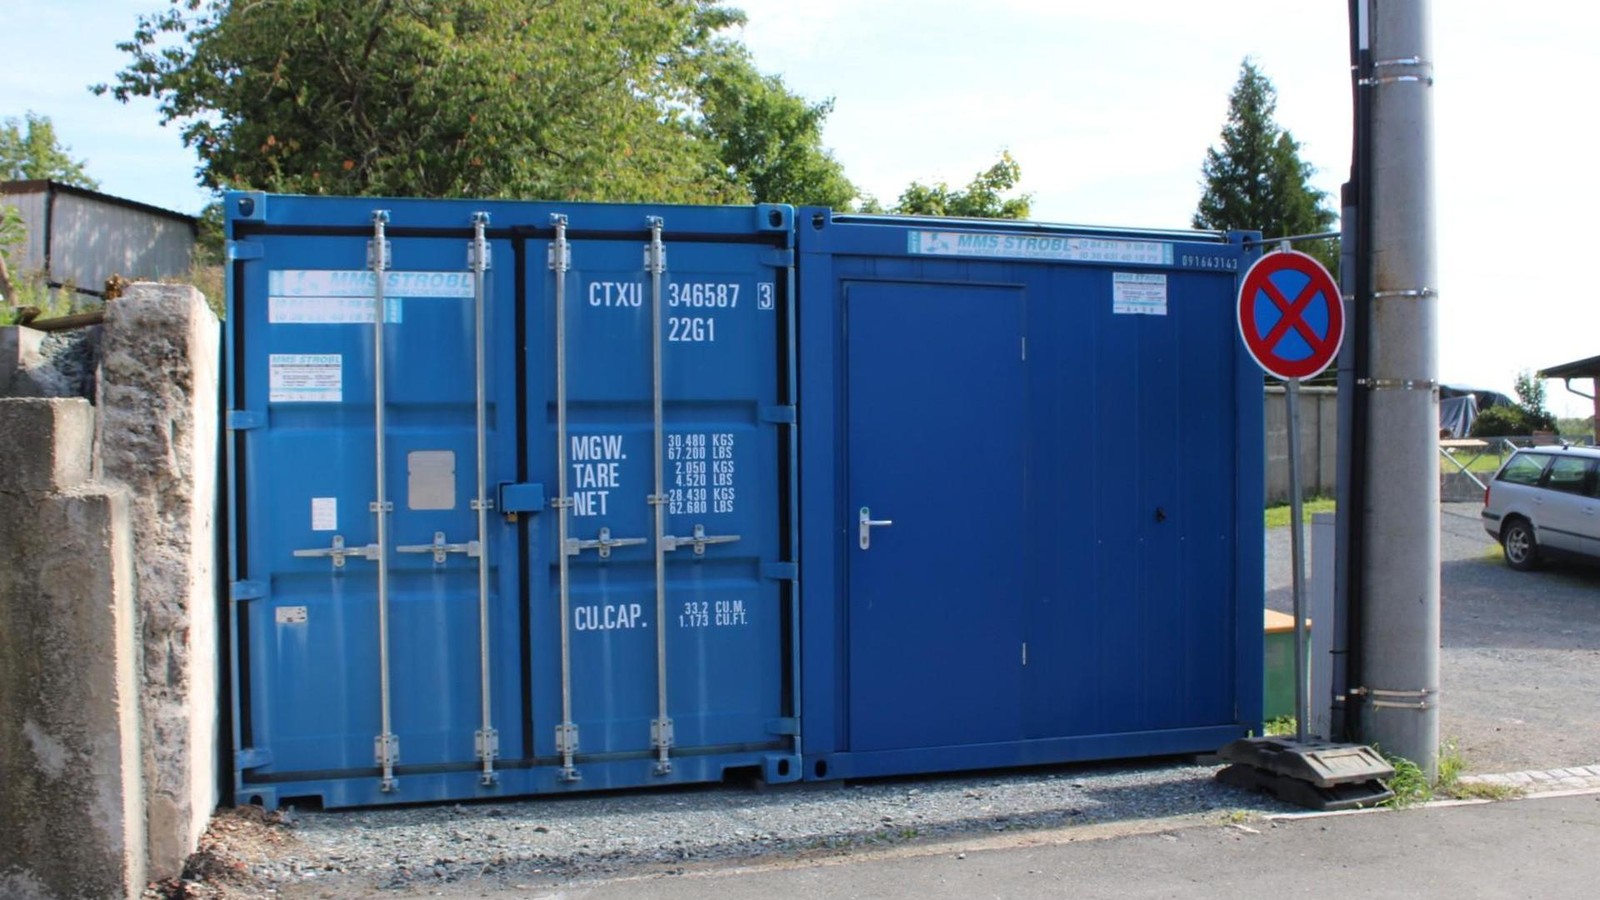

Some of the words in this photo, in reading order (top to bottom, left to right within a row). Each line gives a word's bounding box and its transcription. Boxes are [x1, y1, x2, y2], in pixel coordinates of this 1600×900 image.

[958, 234, 998, 248] MMS
[1003, 236, 1071, 251] STROBL
[330, 272, 376, 287] MMS
[386, 273, 471, 289] STROBL
[588, 281, 643, 307] CTXU
[668, 283, 740, 308] 346587
[760, 284, 771, 308] 3
[668, 317, 715, 342] 22G1
[571, 435, 627, 461] MGW.
[668, 434, 706, 447] 30.480
[712, 433, 734, 446] KGS
[668, 447, 706, 460] 67.200
[712, 446, 733, 459] LBS
[572, 463, 620, 488] TARE
[675, 461, 706, 475] 2.050
[712, 460, 735, 474] KGS
[675, 474, 706, 487] 4.520
[713, 473, 733, 486] LBS
[669, 489, 707, 502] 28.430
[713, 488, 735, 501] KGS
[573, 491, 609, 516] NET
[669, 501, 707, 514] 62.680
[713, 500, 733, 513] LBS
[684, 602, 709, 615] 33.2
[715, 600, 747, 614] CU.M.
[574, 603, 647, 631] CU.CAP.
[679, 614, 709, 628] 1.173
[715, 612, 748, 626] CU.FT.
